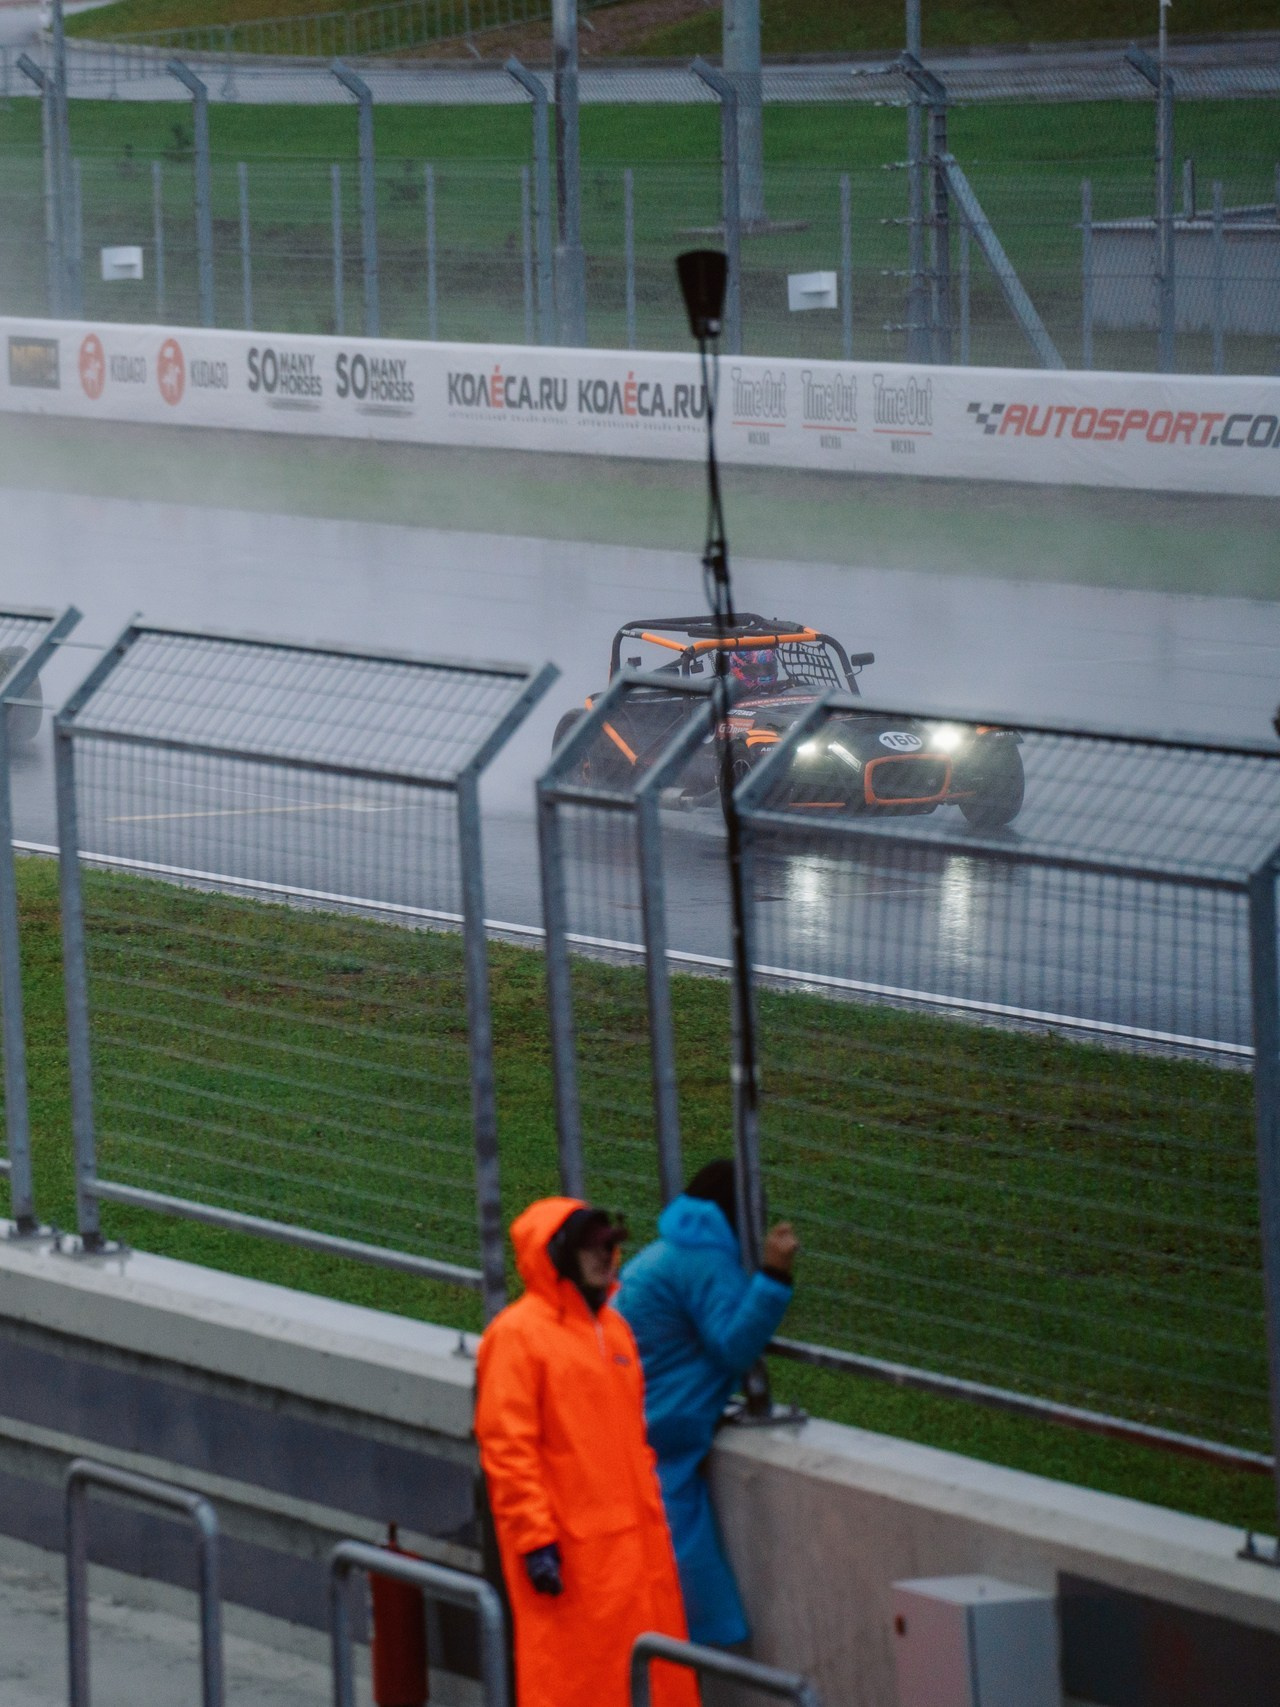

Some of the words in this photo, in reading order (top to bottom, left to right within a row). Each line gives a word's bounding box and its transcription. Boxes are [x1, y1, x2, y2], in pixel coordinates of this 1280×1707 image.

[247, 347, 278, 394] SO
[279, 353, 315, 373] MANY
[280, 374, 322, 397] HORSES
[336, 352, 368, 399] SO
[370, 358, 407, 380] MANY
[370, 381, 415, 402] HORSES
[999, 403, 1280, 448] AUTOSPORT.CO
[883, 733, 920, 747] 160
